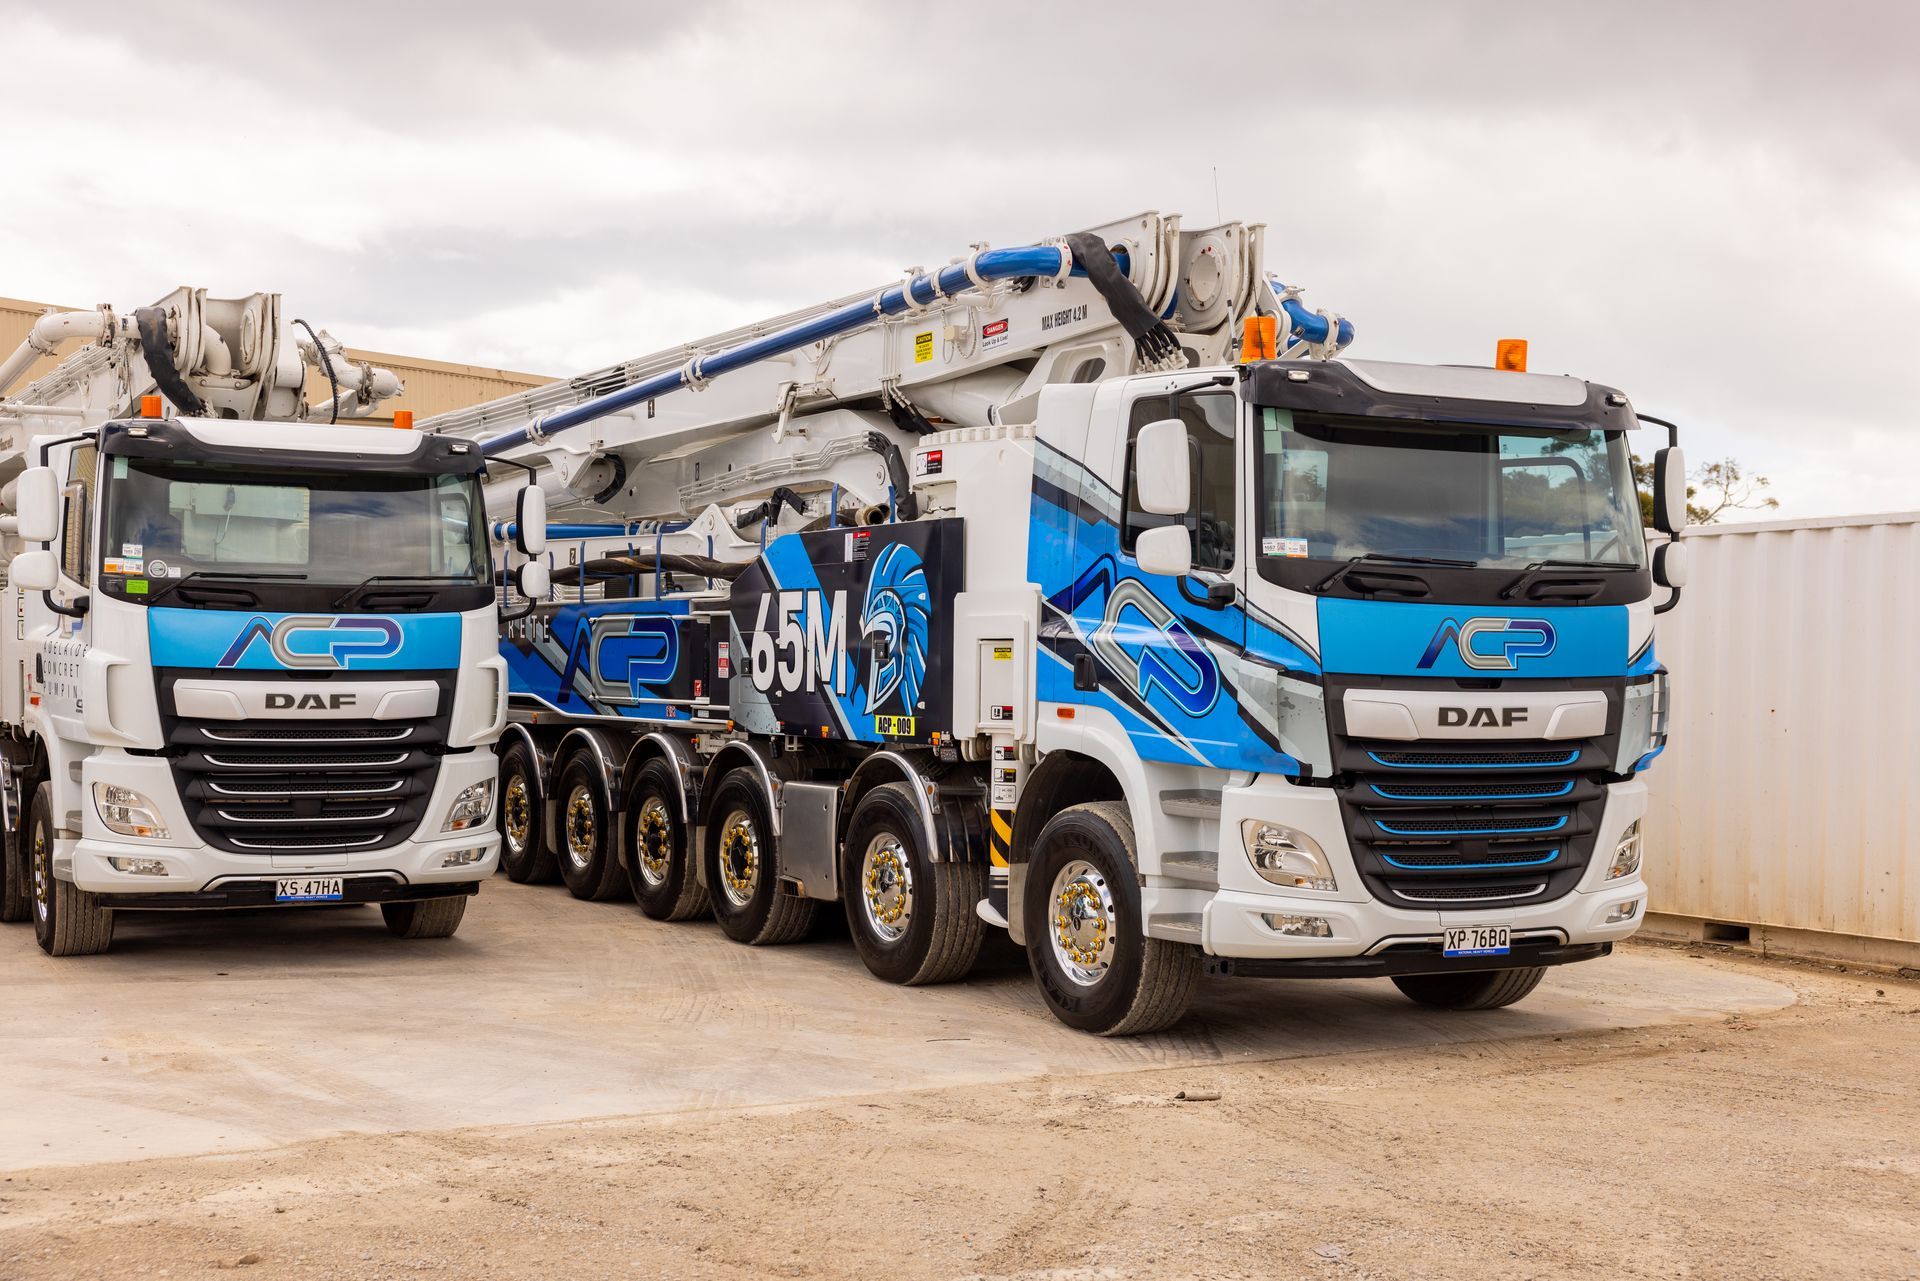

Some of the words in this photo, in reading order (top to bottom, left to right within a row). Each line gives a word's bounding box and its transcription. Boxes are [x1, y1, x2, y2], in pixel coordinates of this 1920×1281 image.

[986, 323, 1004, 334] DANGER
[1041, 315, 1054, 331] MAX
[1054, 309, 1073, 328] HEIGHT
[1073, 307, 1082, 322] 4.2
[1082, 304, 1088, 319] M
[498, 615, 550, 639] RETE
[215, 615, 405, 670] ACP
[751, 590, 847, 694] 65M
[1416, 616, 1557, 670] ACP
[43, 660, 80, 678] CONCRET
[43, 680, 83, 699] PUMPIN
[265, 693, 356, 710] DAF
[1437, 706, 1529, 727] DAF
